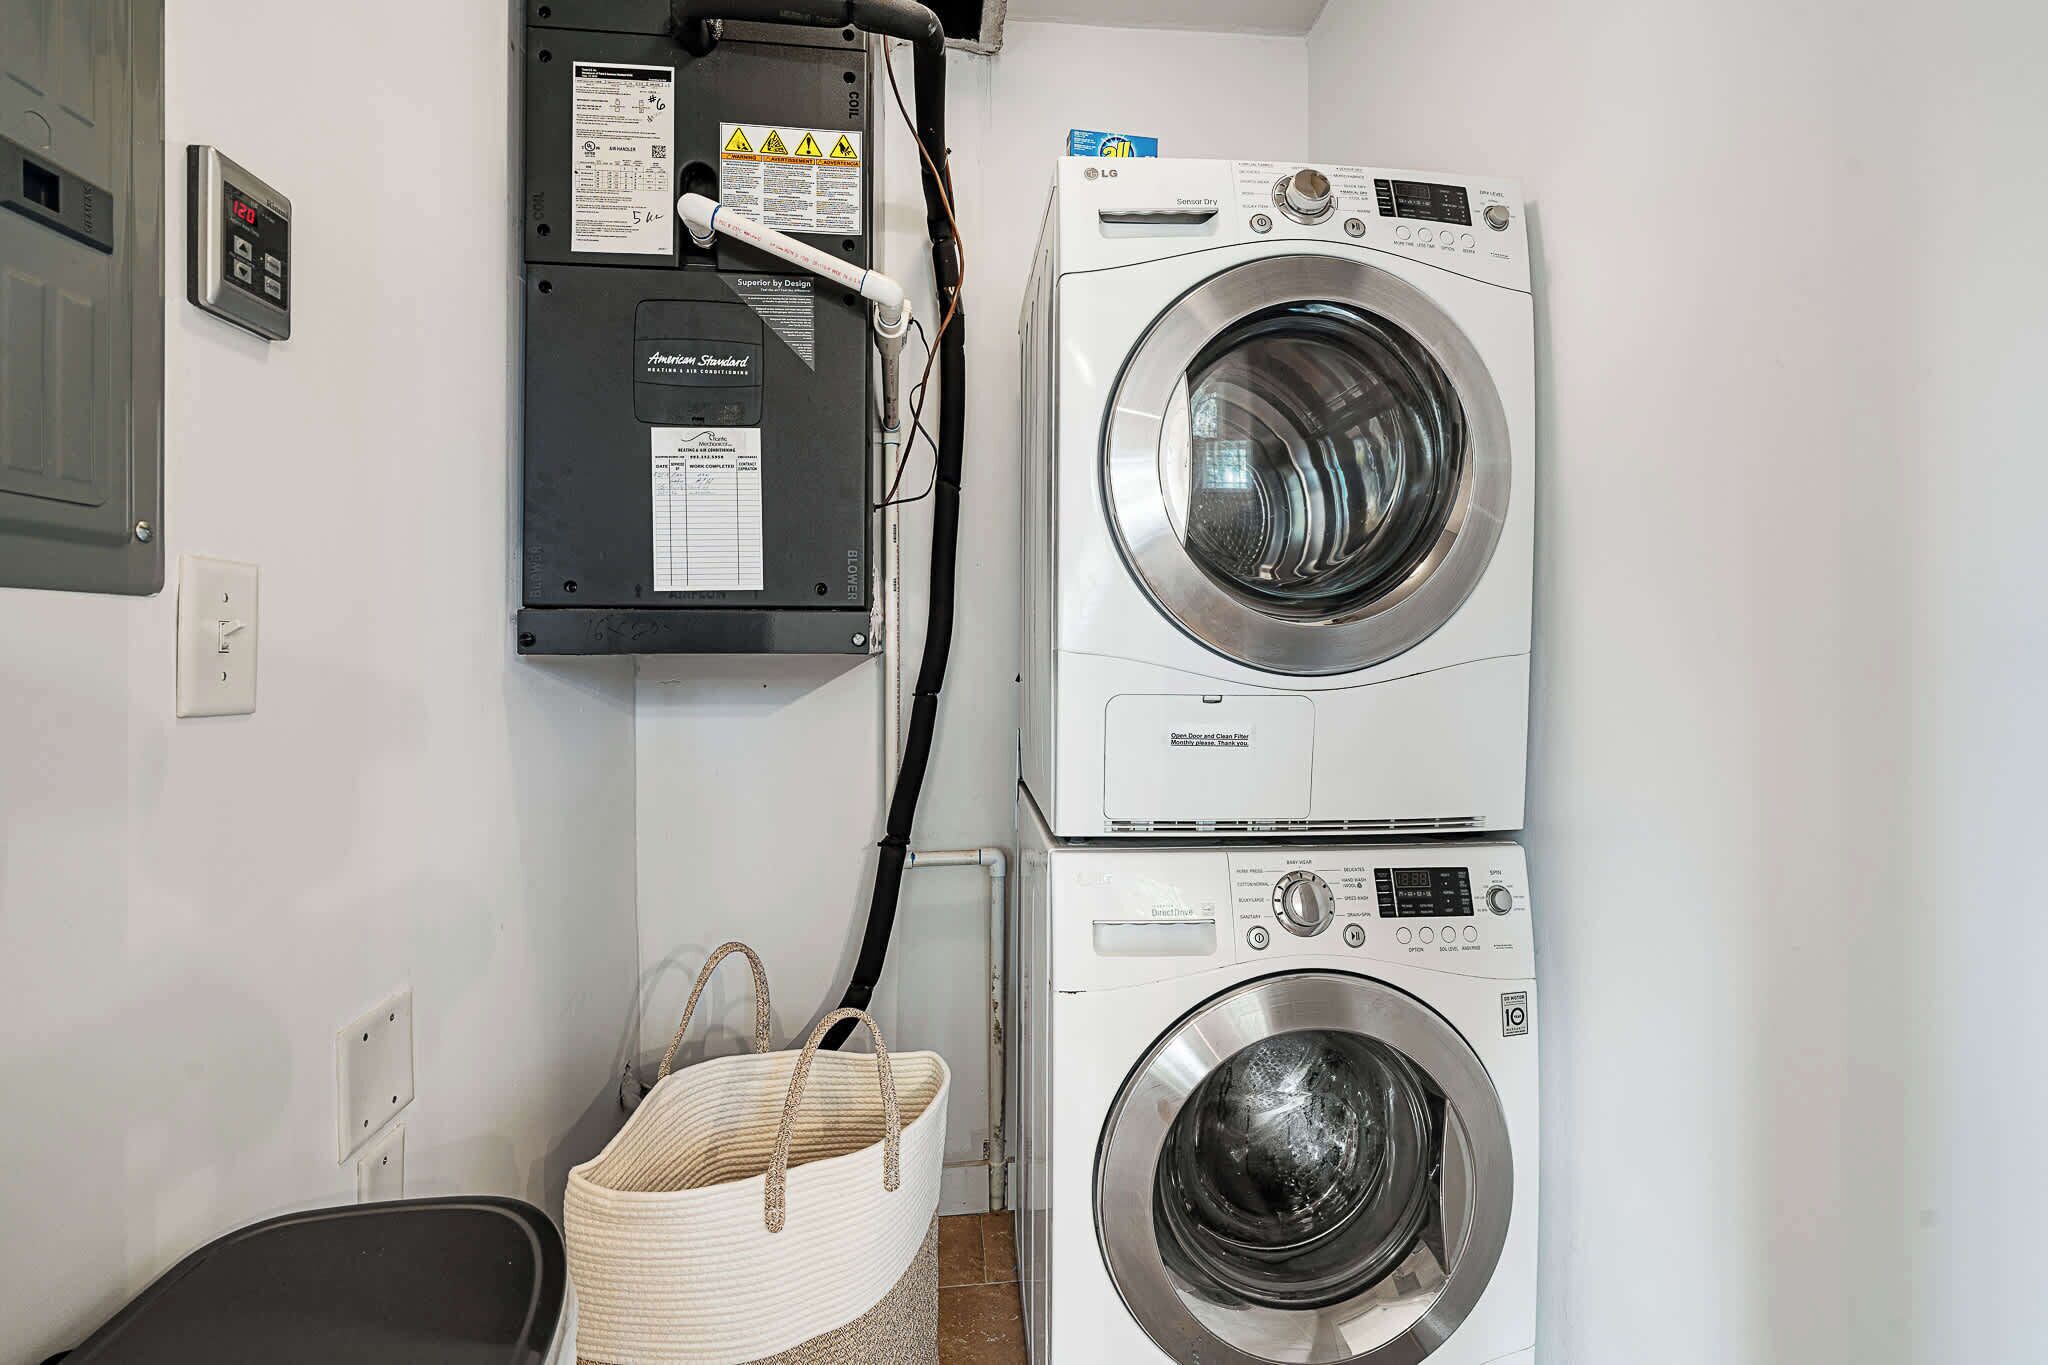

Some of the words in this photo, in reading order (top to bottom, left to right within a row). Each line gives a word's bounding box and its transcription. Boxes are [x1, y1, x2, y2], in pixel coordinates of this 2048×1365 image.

[848, 91, 860, 119] COIL
[1102, 141, 1131, 157] all
[771, 156, 813, 164] AVERTISSEMENT
[1101, 169, 1118, 177] LG
[737, 278, 770, 287] Superior
[772, 280, 782, 288] by
[784, 280, 811, 288] Design
[647, 352, 696, 365] American
[697, 355, 750, 368] Standard
[847, 550, 858, 600] BLOWER
